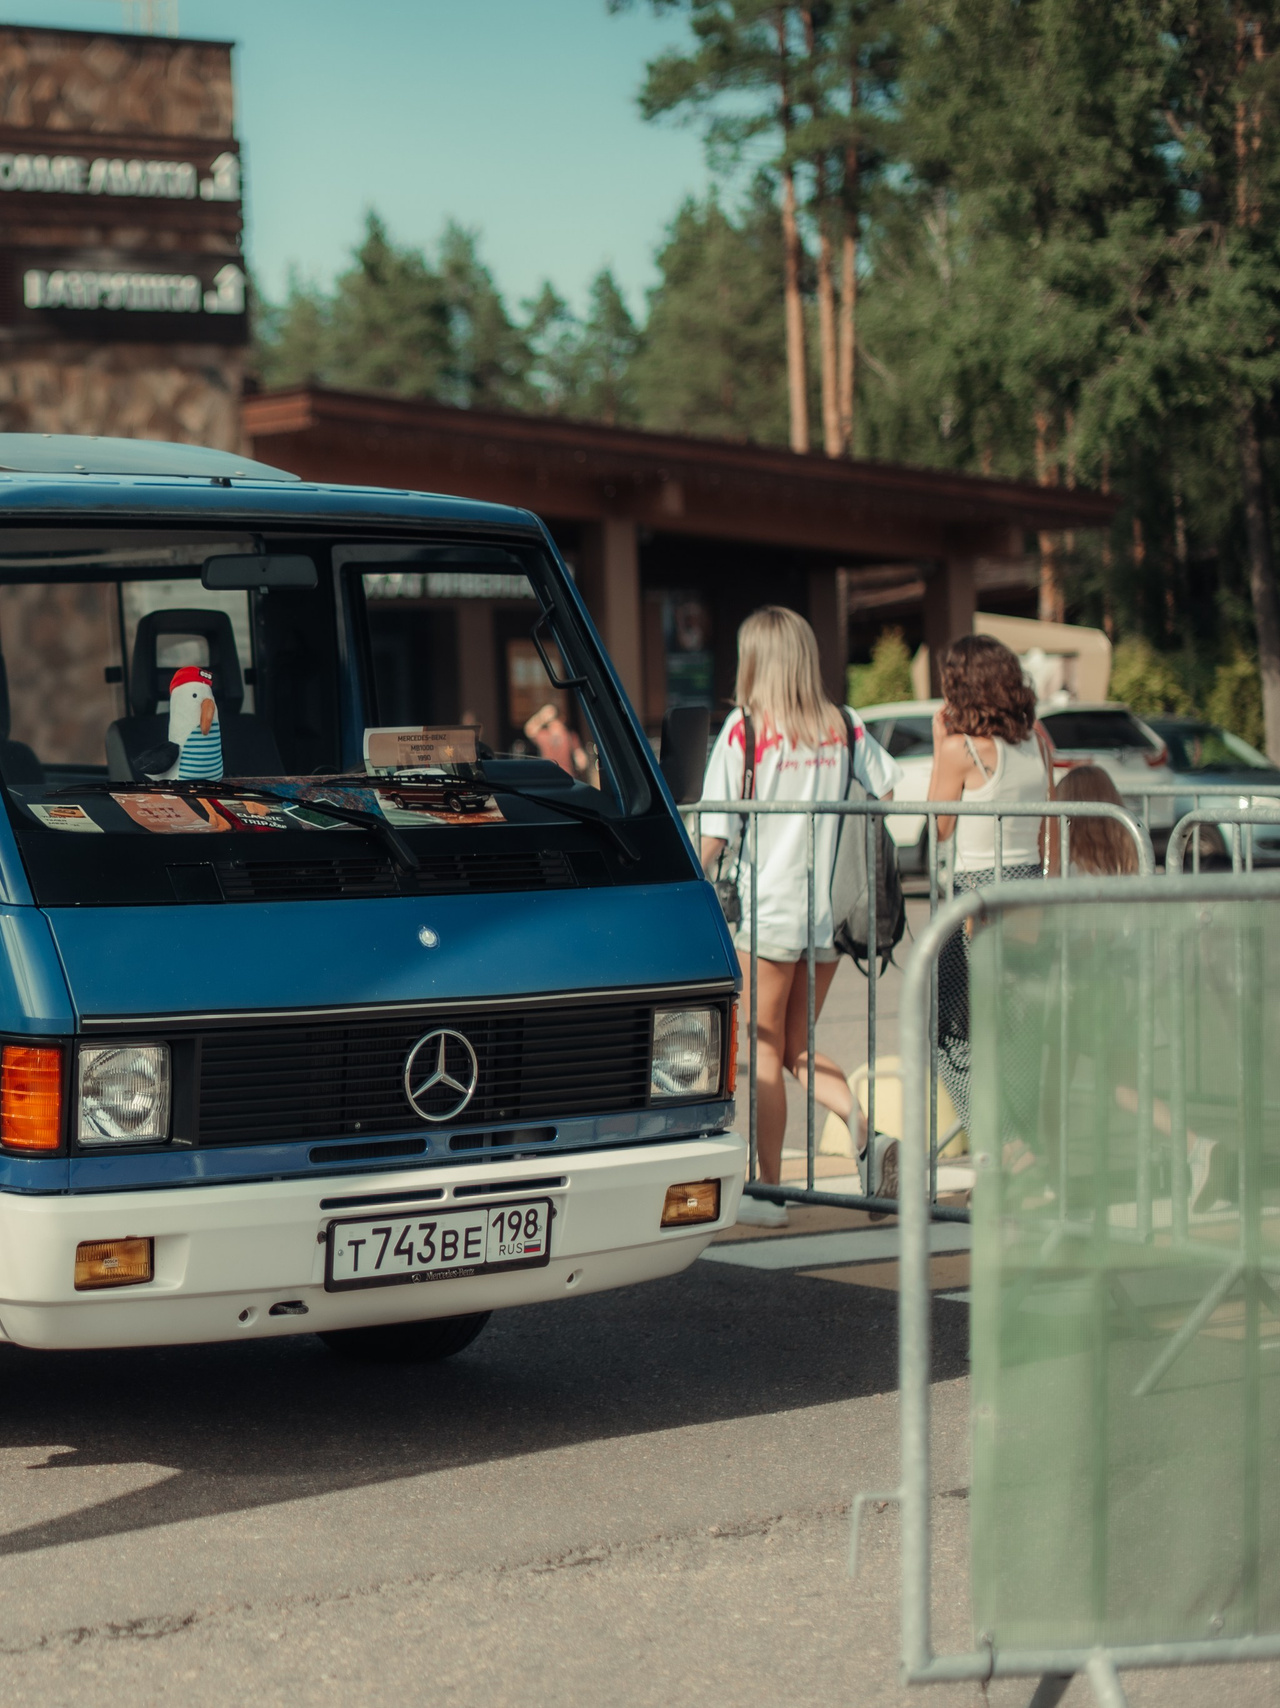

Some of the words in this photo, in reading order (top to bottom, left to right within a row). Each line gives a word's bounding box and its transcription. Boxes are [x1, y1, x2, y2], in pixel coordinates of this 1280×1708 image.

[397, 734, 447, 742] MERCEDES-BENZ
[241, 818, 269, 826] TRIP
[491, 1208, 539, 1243] 198
[498, 1243, 524, 1256] RUS
[426, 1268, 475, 1281] Mercedes-Benz
